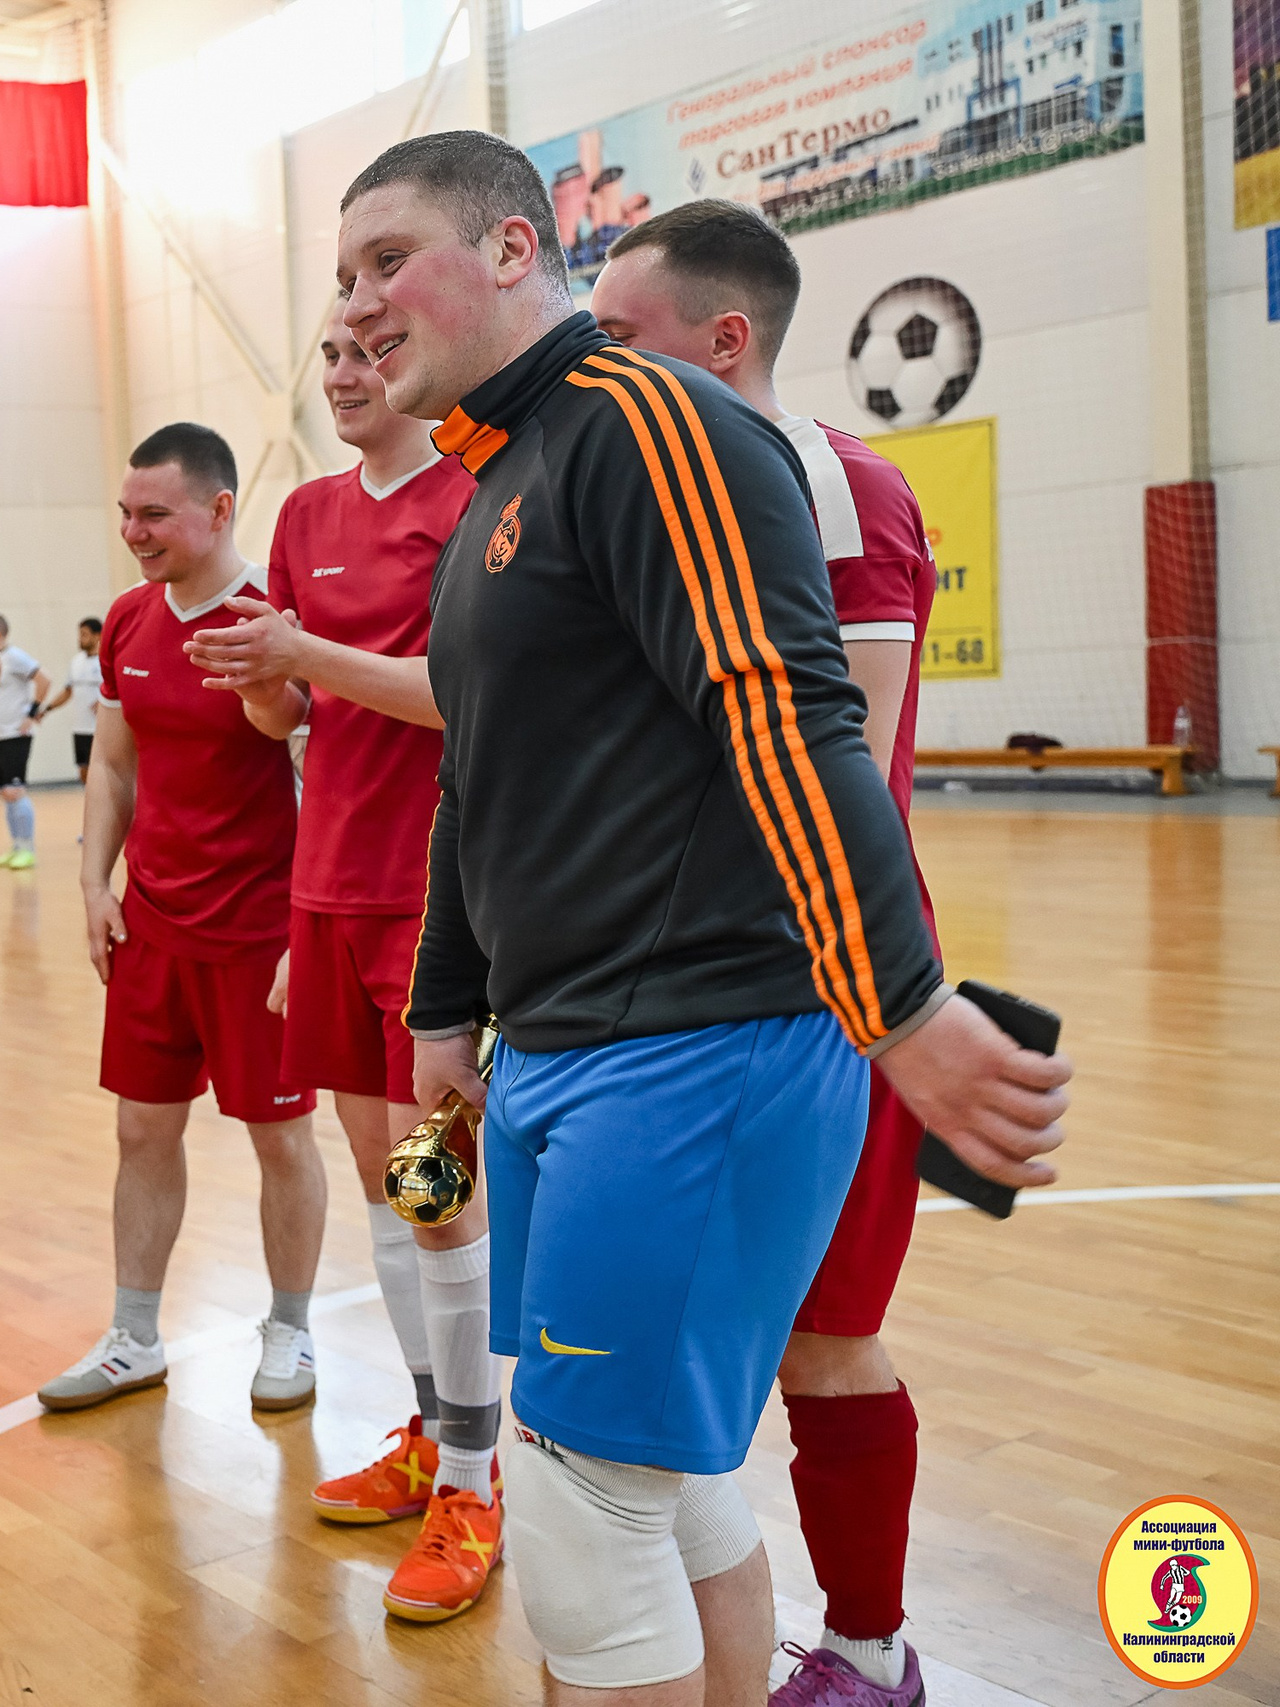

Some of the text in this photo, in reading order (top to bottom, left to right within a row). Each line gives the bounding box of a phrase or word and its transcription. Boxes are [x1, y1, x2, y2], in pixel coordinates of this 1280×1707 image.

[667, 19, 927, 124] Генеральный спонсор
[678, 57, 914, 150] торговая компания
[716, 108, 891, 179] СанТермо
